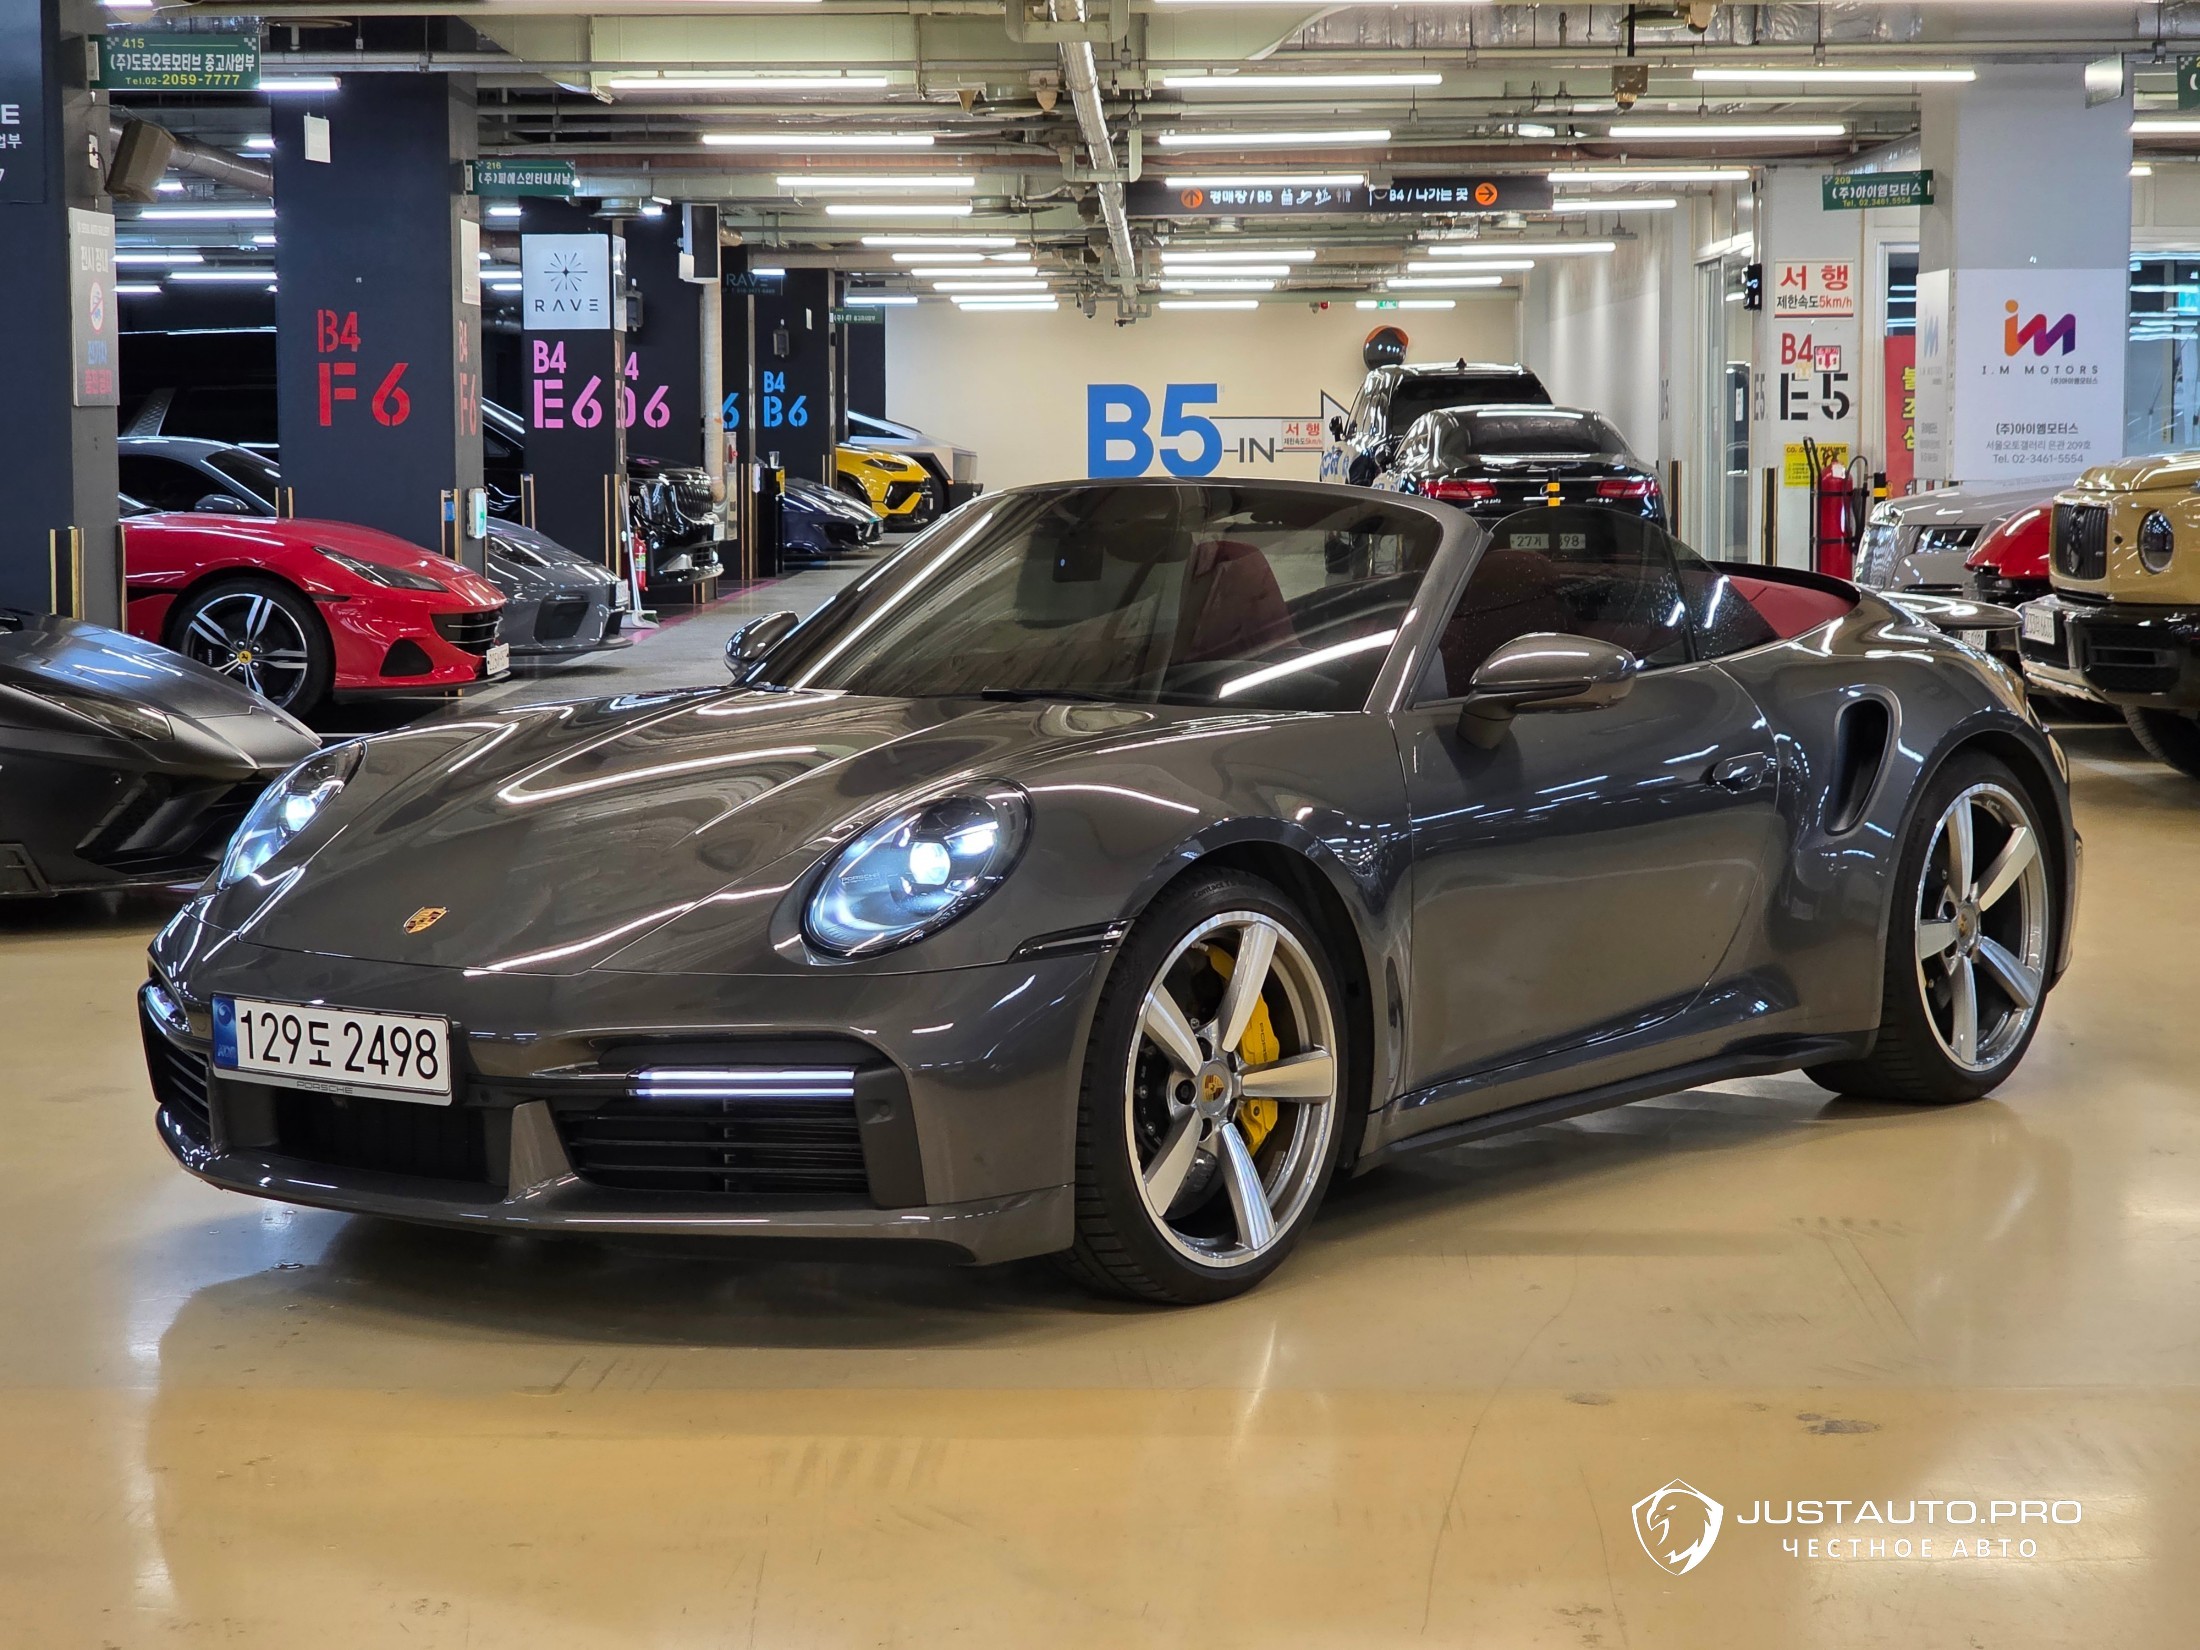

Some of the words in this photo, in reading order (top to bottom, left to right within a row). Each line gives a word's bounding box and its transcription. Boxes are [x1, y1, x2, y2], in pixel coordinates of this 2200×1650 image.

[122, 38, 145, 49] 415
[110, 53, 202, 72] (주)도로오토모티브
[204, 53, 255, 72] 중고사업부
[1415, 187, 1452, 203] 나가는
[317, 309, 362, 353] B4
[533, 339, 567, 374] B4
[1781, 332, 1814, 366] B4
[624, 351, 640, 381] 4
[2024, 365, 2099, 375] MOTORS
[763, 371, 785, 393] B4
[533, 375, 603, 429] E6
[763, 395, 808, 428] B6
[1087, 383, 1223, 479] B5
[1995, 423, 2079, 436] (주)아이엠모터스
[1239, 437, 1275, 463] IN
[2012, 454, 2084, 464] 02-3461-5554
[240, 1010, 332, 1068] 129도
[343, 1021, 439, 1080] 2498
[296, 1080, 354, 1095] PORSCHE
